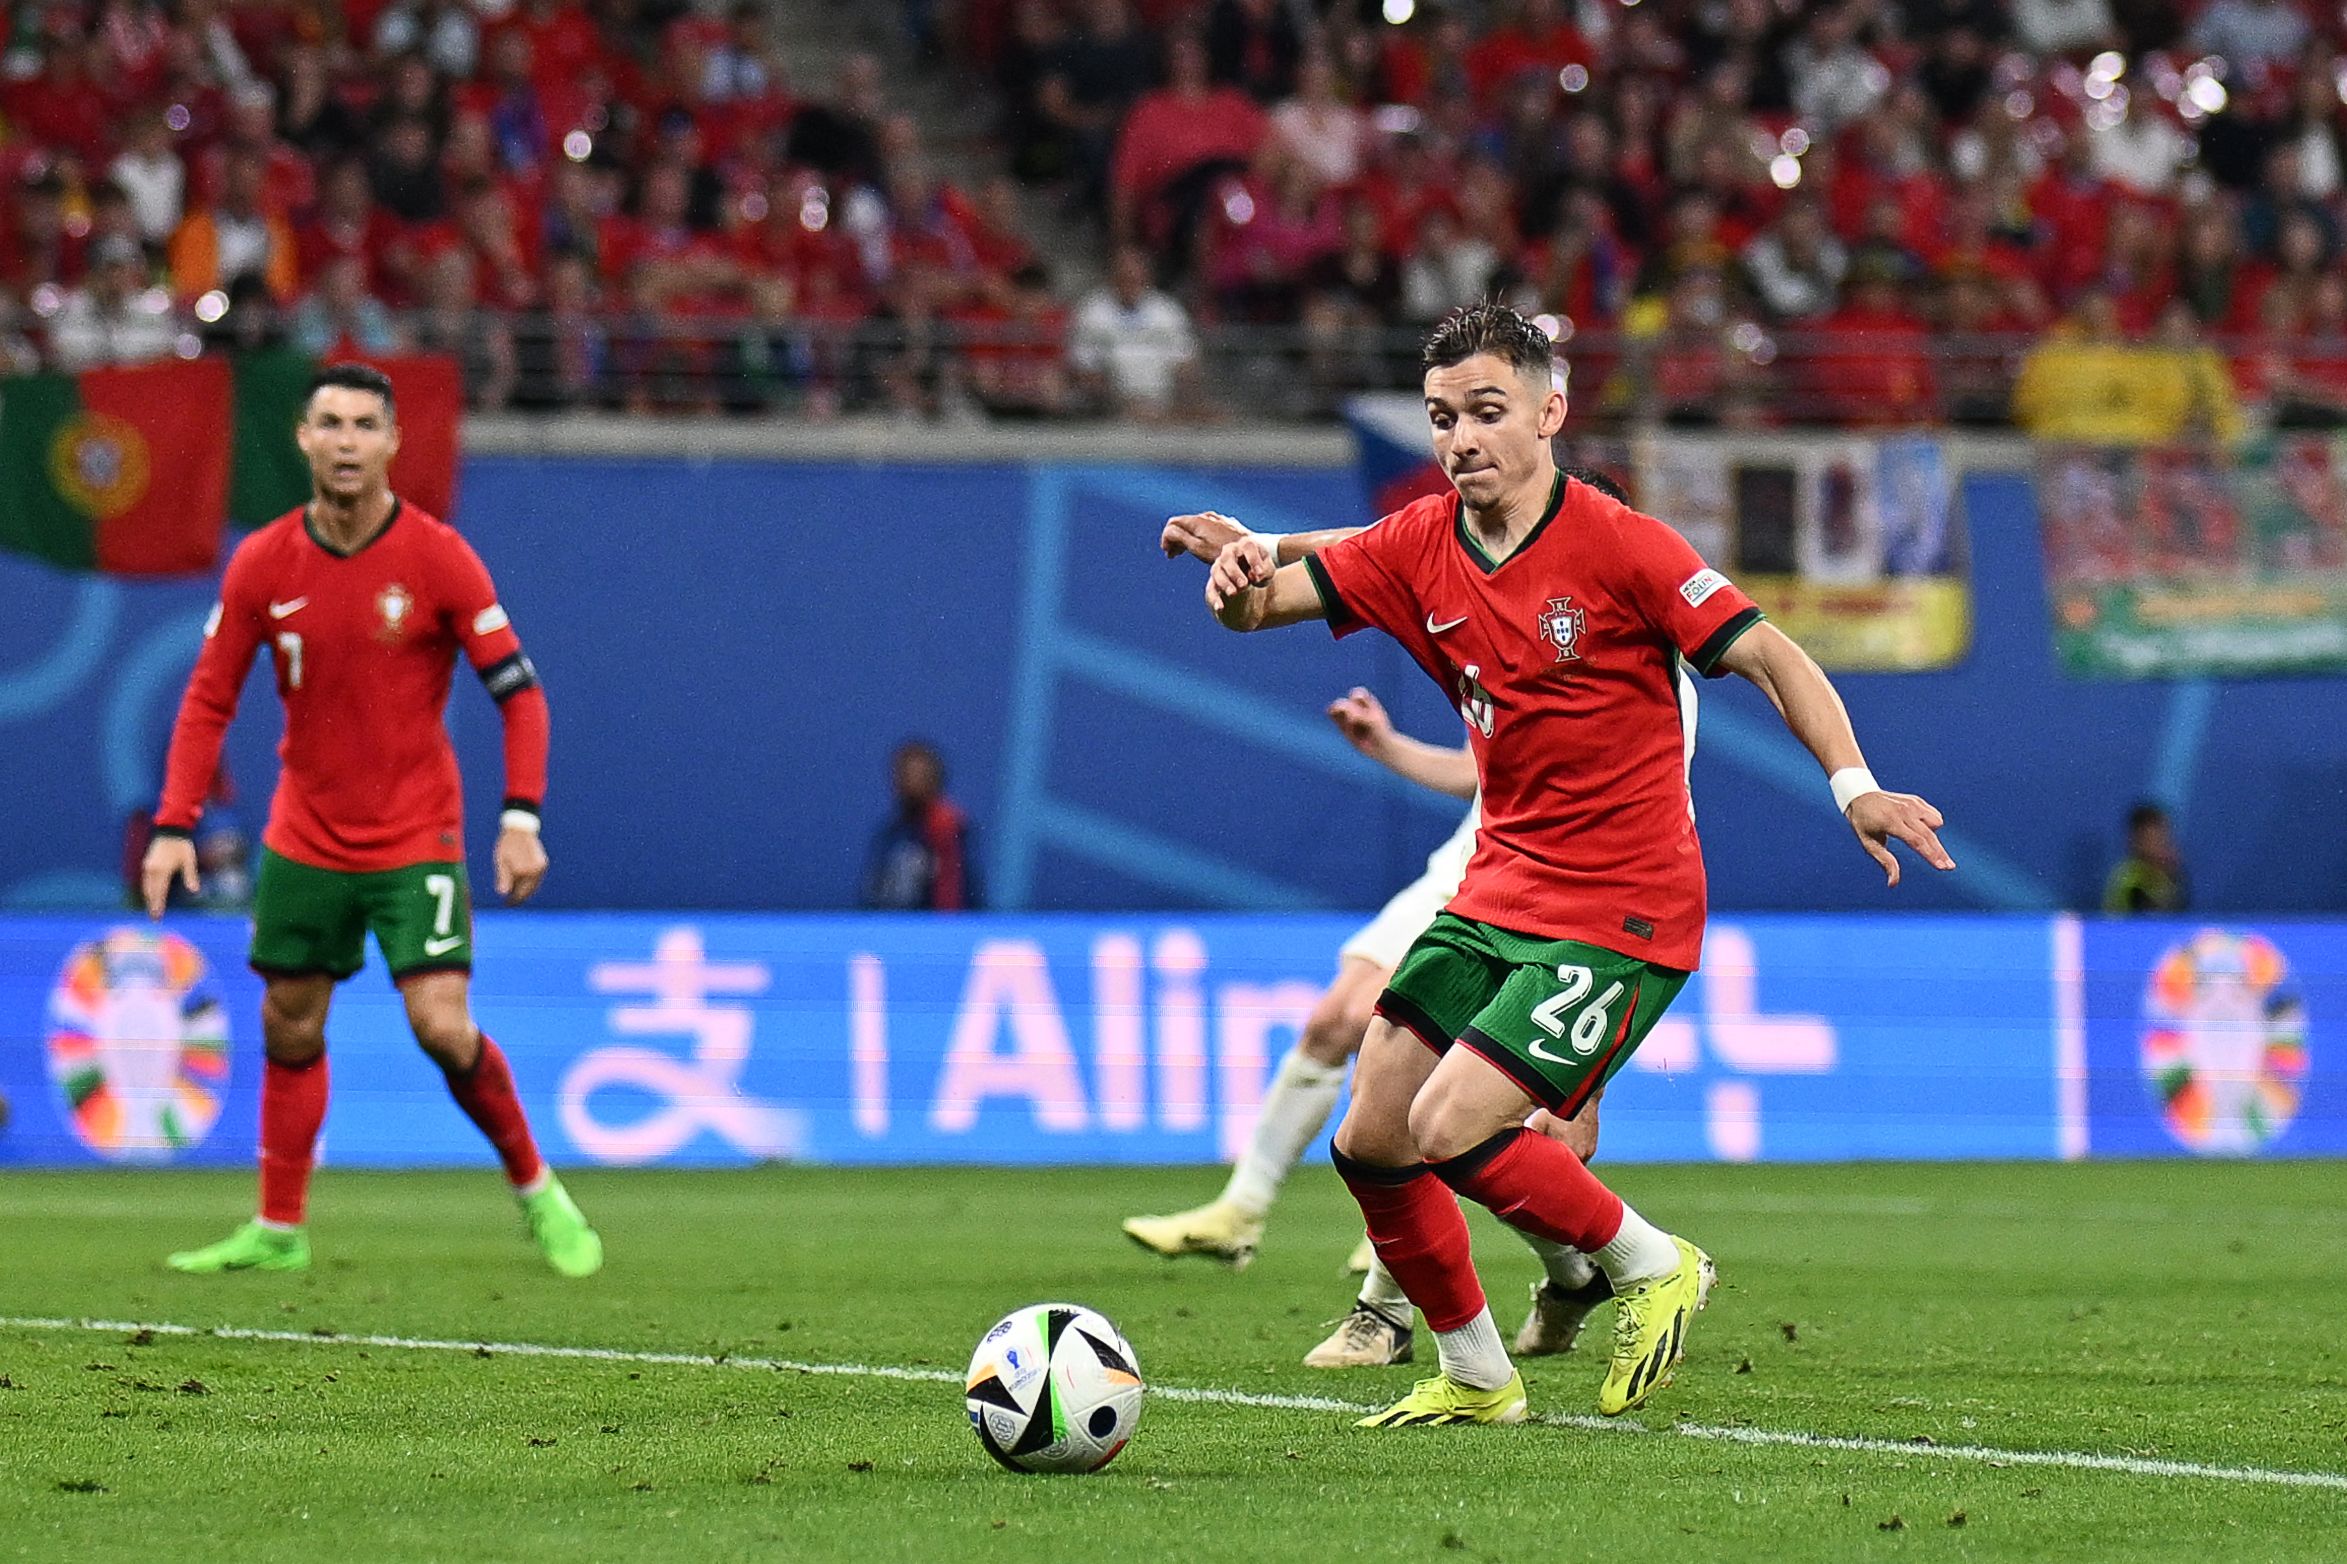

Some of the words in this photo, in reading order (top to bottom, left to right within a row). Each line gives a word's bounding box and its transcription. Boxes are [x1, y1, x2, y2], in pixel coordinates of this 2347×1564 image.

[278, 631, 303, 691] 7
[425, 874, 455, 936] 7
[1530, 963, 1625, 1056] 26
